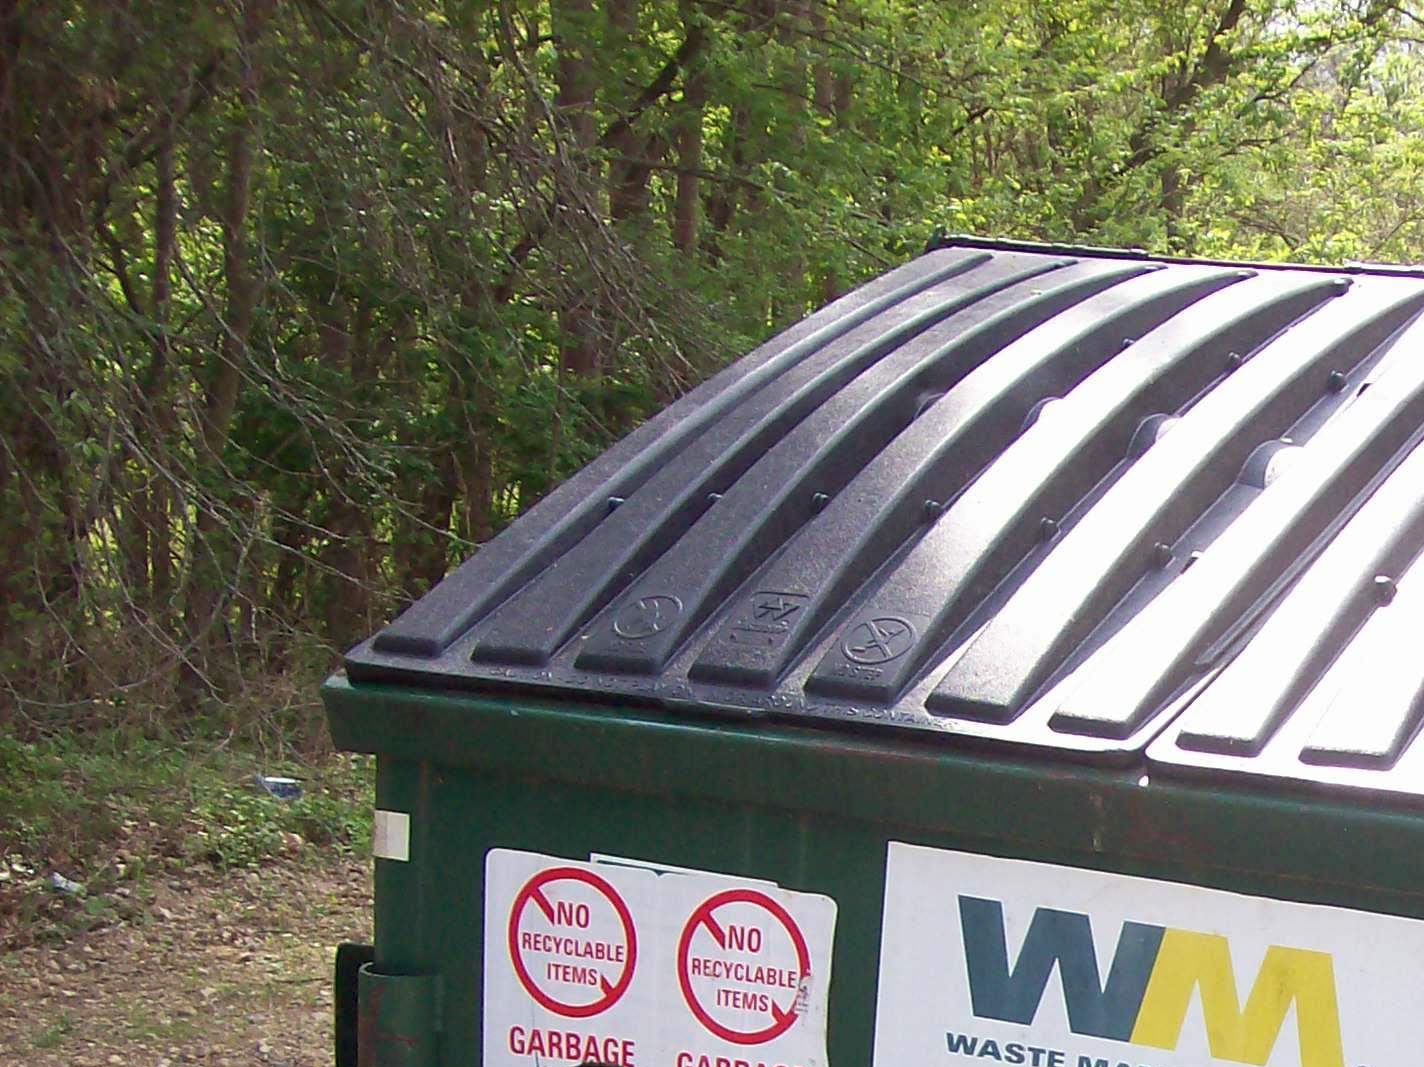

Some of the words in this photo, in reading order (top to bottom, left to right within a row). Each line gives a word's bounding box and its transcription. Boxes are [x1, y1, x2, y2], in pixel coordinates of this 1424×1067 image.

[554, 900, 591, 929] NO
[521, 932, 625, 963] RECYCLABLE
[726, 924, 762, 954] NO
[547, 963, 597, 986] ITEMS
[691, 958, 798, 989] RECYCLABLE
[716, 989, 770, 1013] ITEMS
